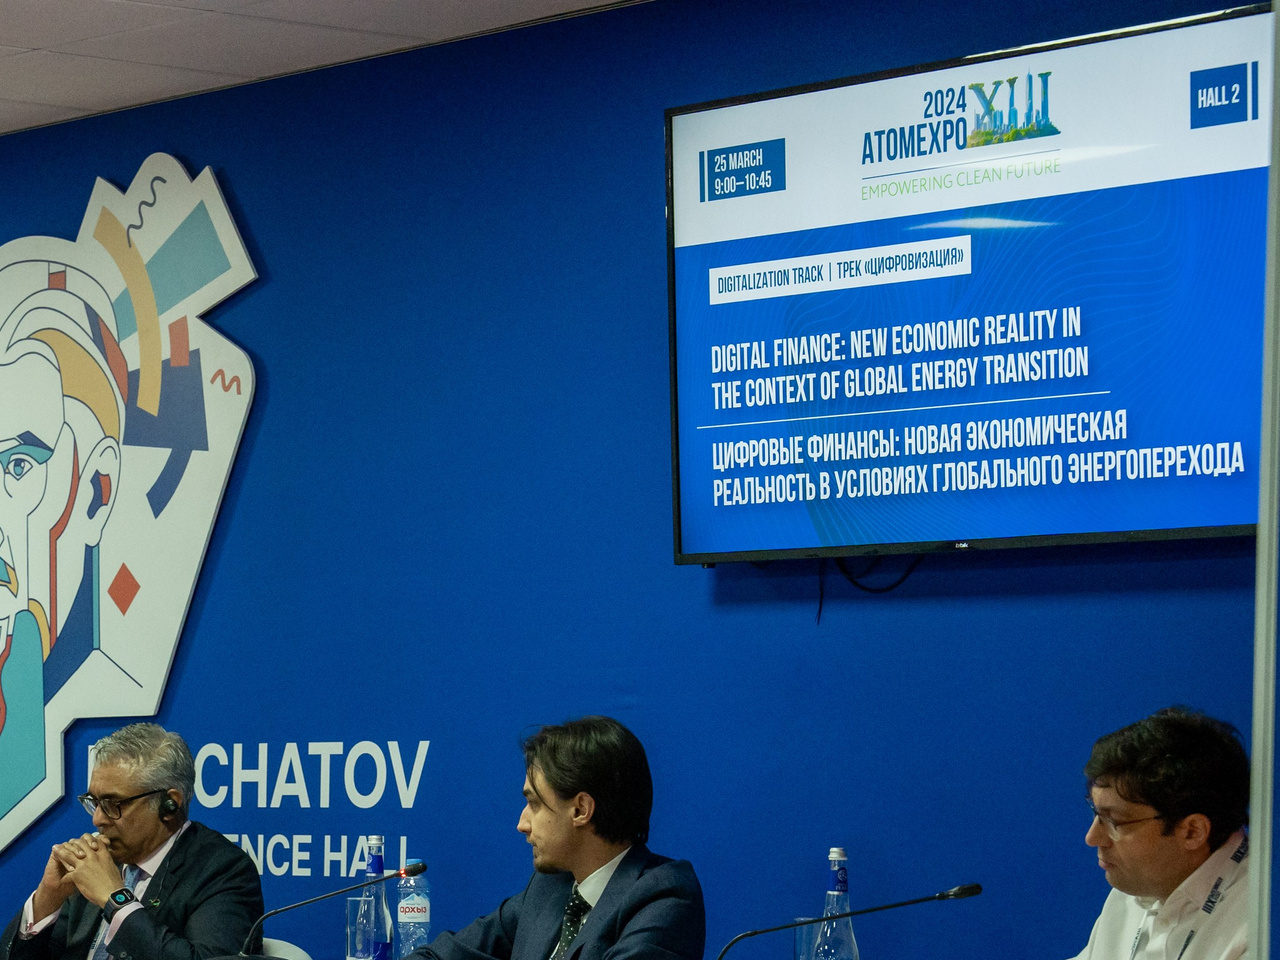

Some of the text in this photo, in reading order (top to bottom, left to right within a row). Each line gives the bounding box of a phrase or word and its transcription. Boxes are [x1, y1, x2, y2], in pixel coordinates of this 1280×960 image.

[924, 85, 967, 118] 2024
[1198, 83, 1240, 109] HALL 2
[714, 149, 763, 173] 25 MARCH
[861, 116, 968, 165] ATOMEXPO
[861, 158, 1061, 201] EMPOWERING CLEAN FUTURE
[717, 264, 824, 294] DIGITALIZATION TRACK
[837, 247, 964, 279] ТРЕК «ЦИФРОВИЗАЦИЯ»
[711, 306, 1081, 373] DIGITAL FINANCE: NEW ECONOMIC REALITY IN
[711, 346, 1089, 410] THE CONTEXT OF GLOBAL ENERGY TRANSITION
[712, 409, 1127, 472] ЦИФРОВЫЕ ФИНАНСЫ: НОВАЯ ЭКОНОМИЧЕСКАЯ
[713, 441, 1245, 507] РЕАЛЬНОСТЬ В УСЛОВИЯХ ГЛОБАЛЬНОГО ЭНЕРГОПЕРЕХОДА
[87, 740, 431, 809] CHATOV
[323, 834, 408, 878] HAL
